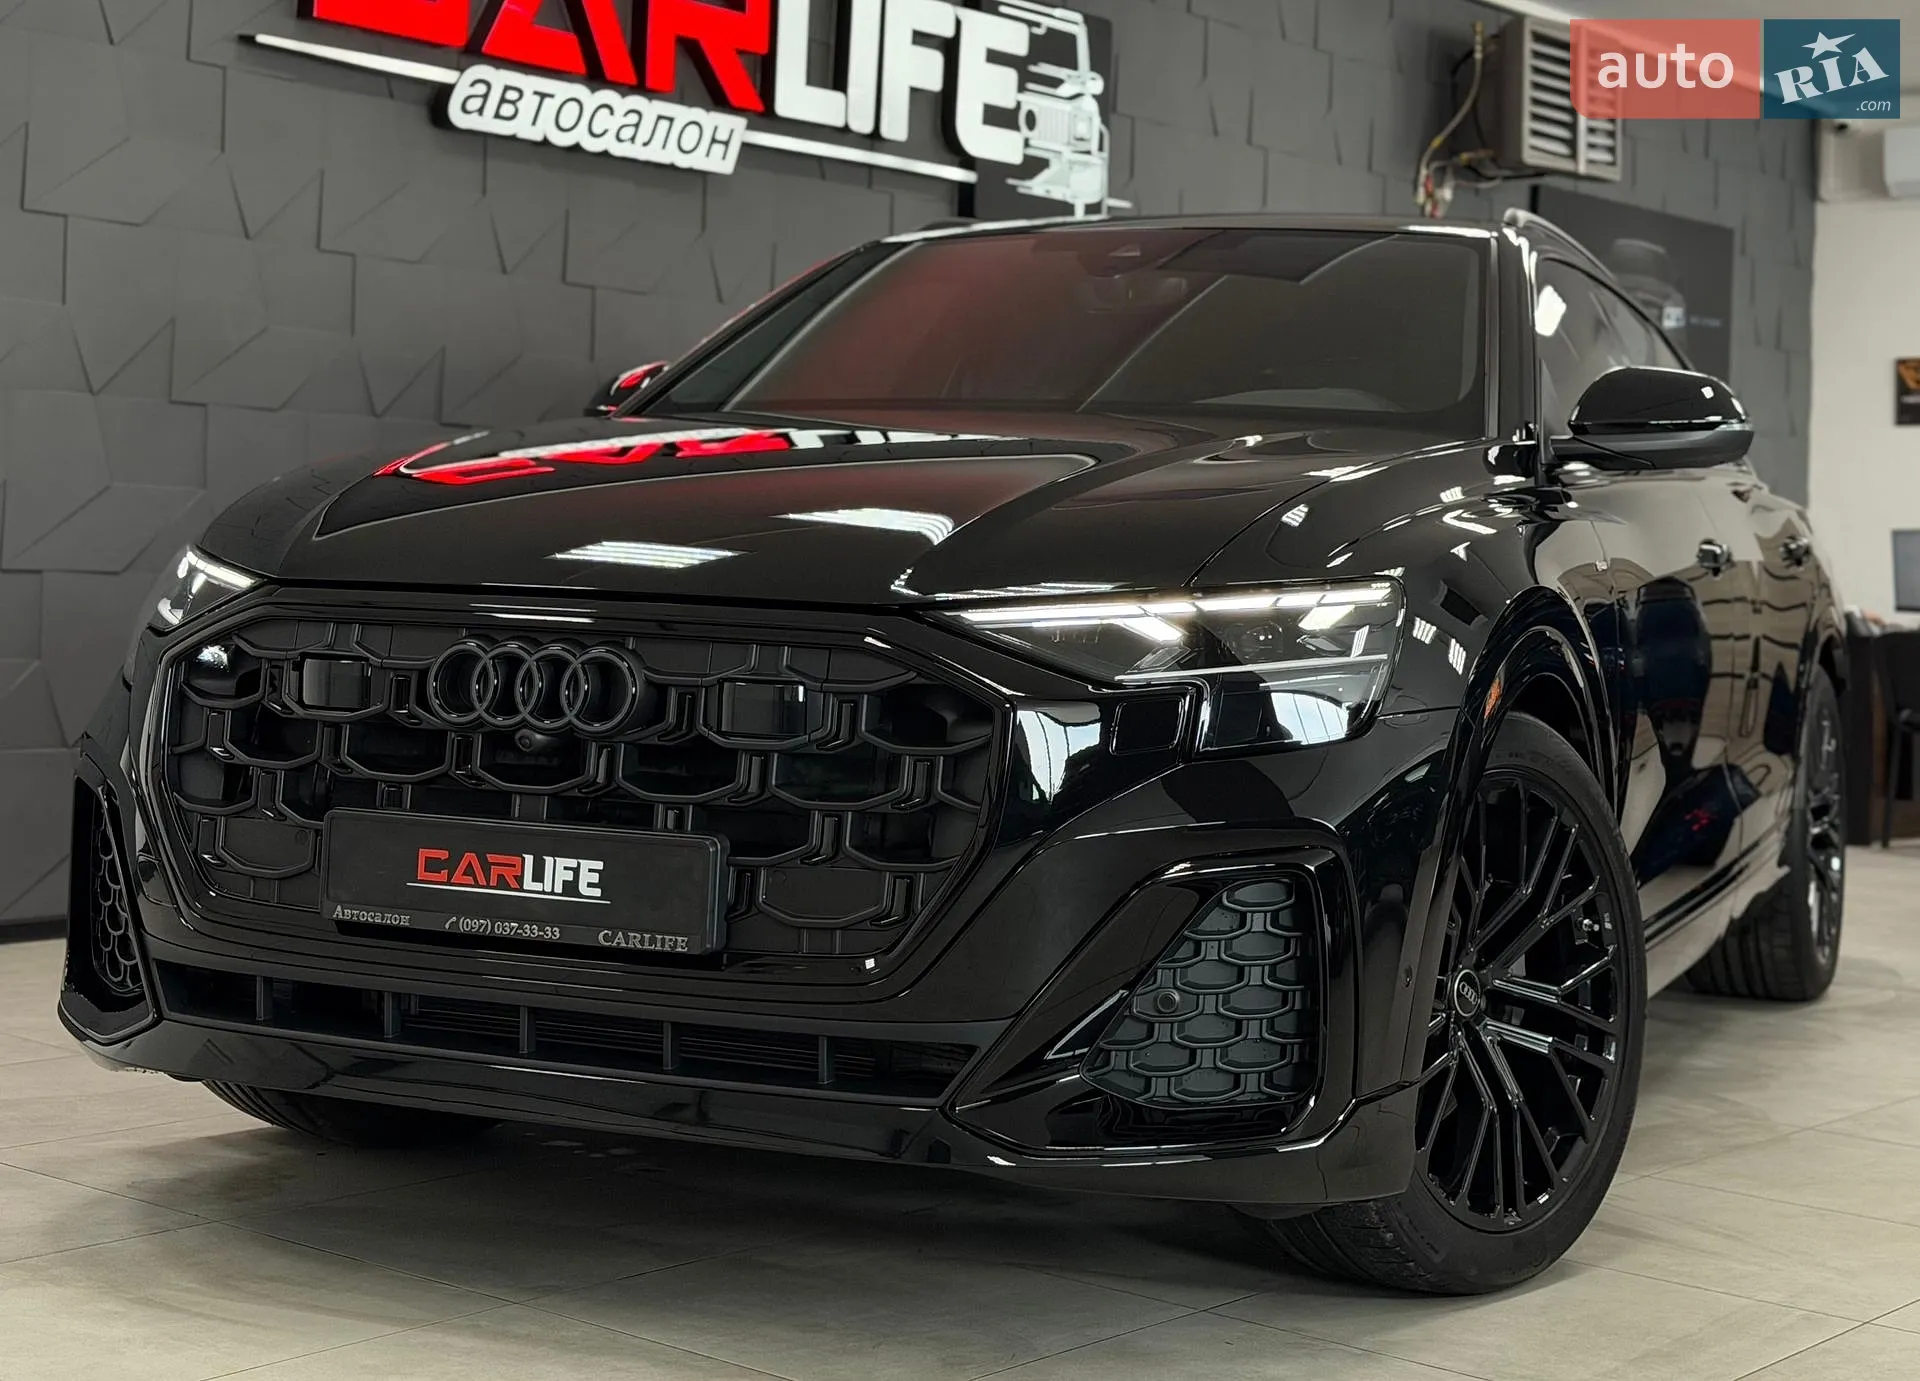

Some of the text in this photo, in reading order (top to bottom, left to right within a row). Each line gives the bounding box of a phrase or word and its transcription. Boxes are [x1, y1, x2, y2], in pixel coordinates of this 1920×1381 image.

[459, 77, 736, 164] автосалон
[416, 847, 605, 898] CARLIFE
[332, 904, 689, 953] Автосалон (097) 037-33-33 CARLIFE
